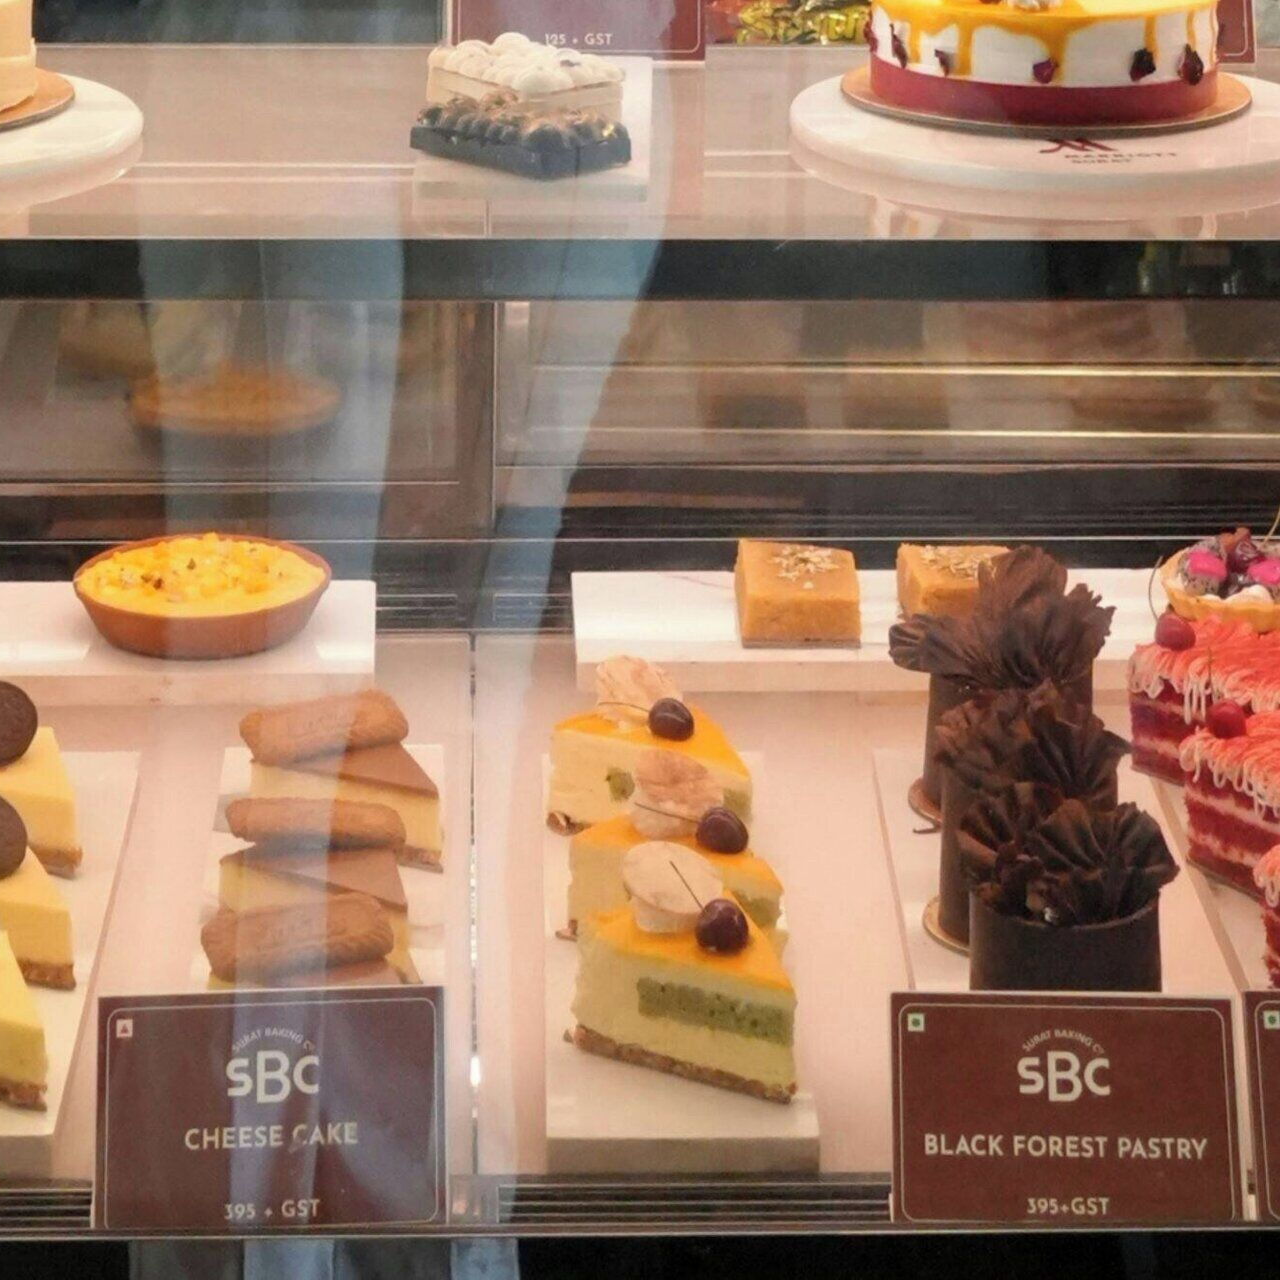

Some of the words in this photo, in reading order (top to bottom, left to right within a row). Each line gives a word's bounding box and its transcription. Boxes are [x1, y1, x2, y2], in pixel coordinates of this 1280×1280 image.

[584, 32, 612, 46] GST
[1022, 1029, 1051, 1052] SURAT
[1054, 1028, 1093, 1047] BAKING
[226, 1050, 320, 1104] SBC
[1017, 1050, 1111, 1102] SBC
[185, 1125, 283, 1150] CHEESE
[291, 1122, 358, 1147] CAKE
[925, 1133, 1004, 1156] BLACK
[1013, 1134, 1108, 1158] FOREST
[1118, 1137, 1208, 1160] PASTRY
[281, 1199, 320, 1219] GST
